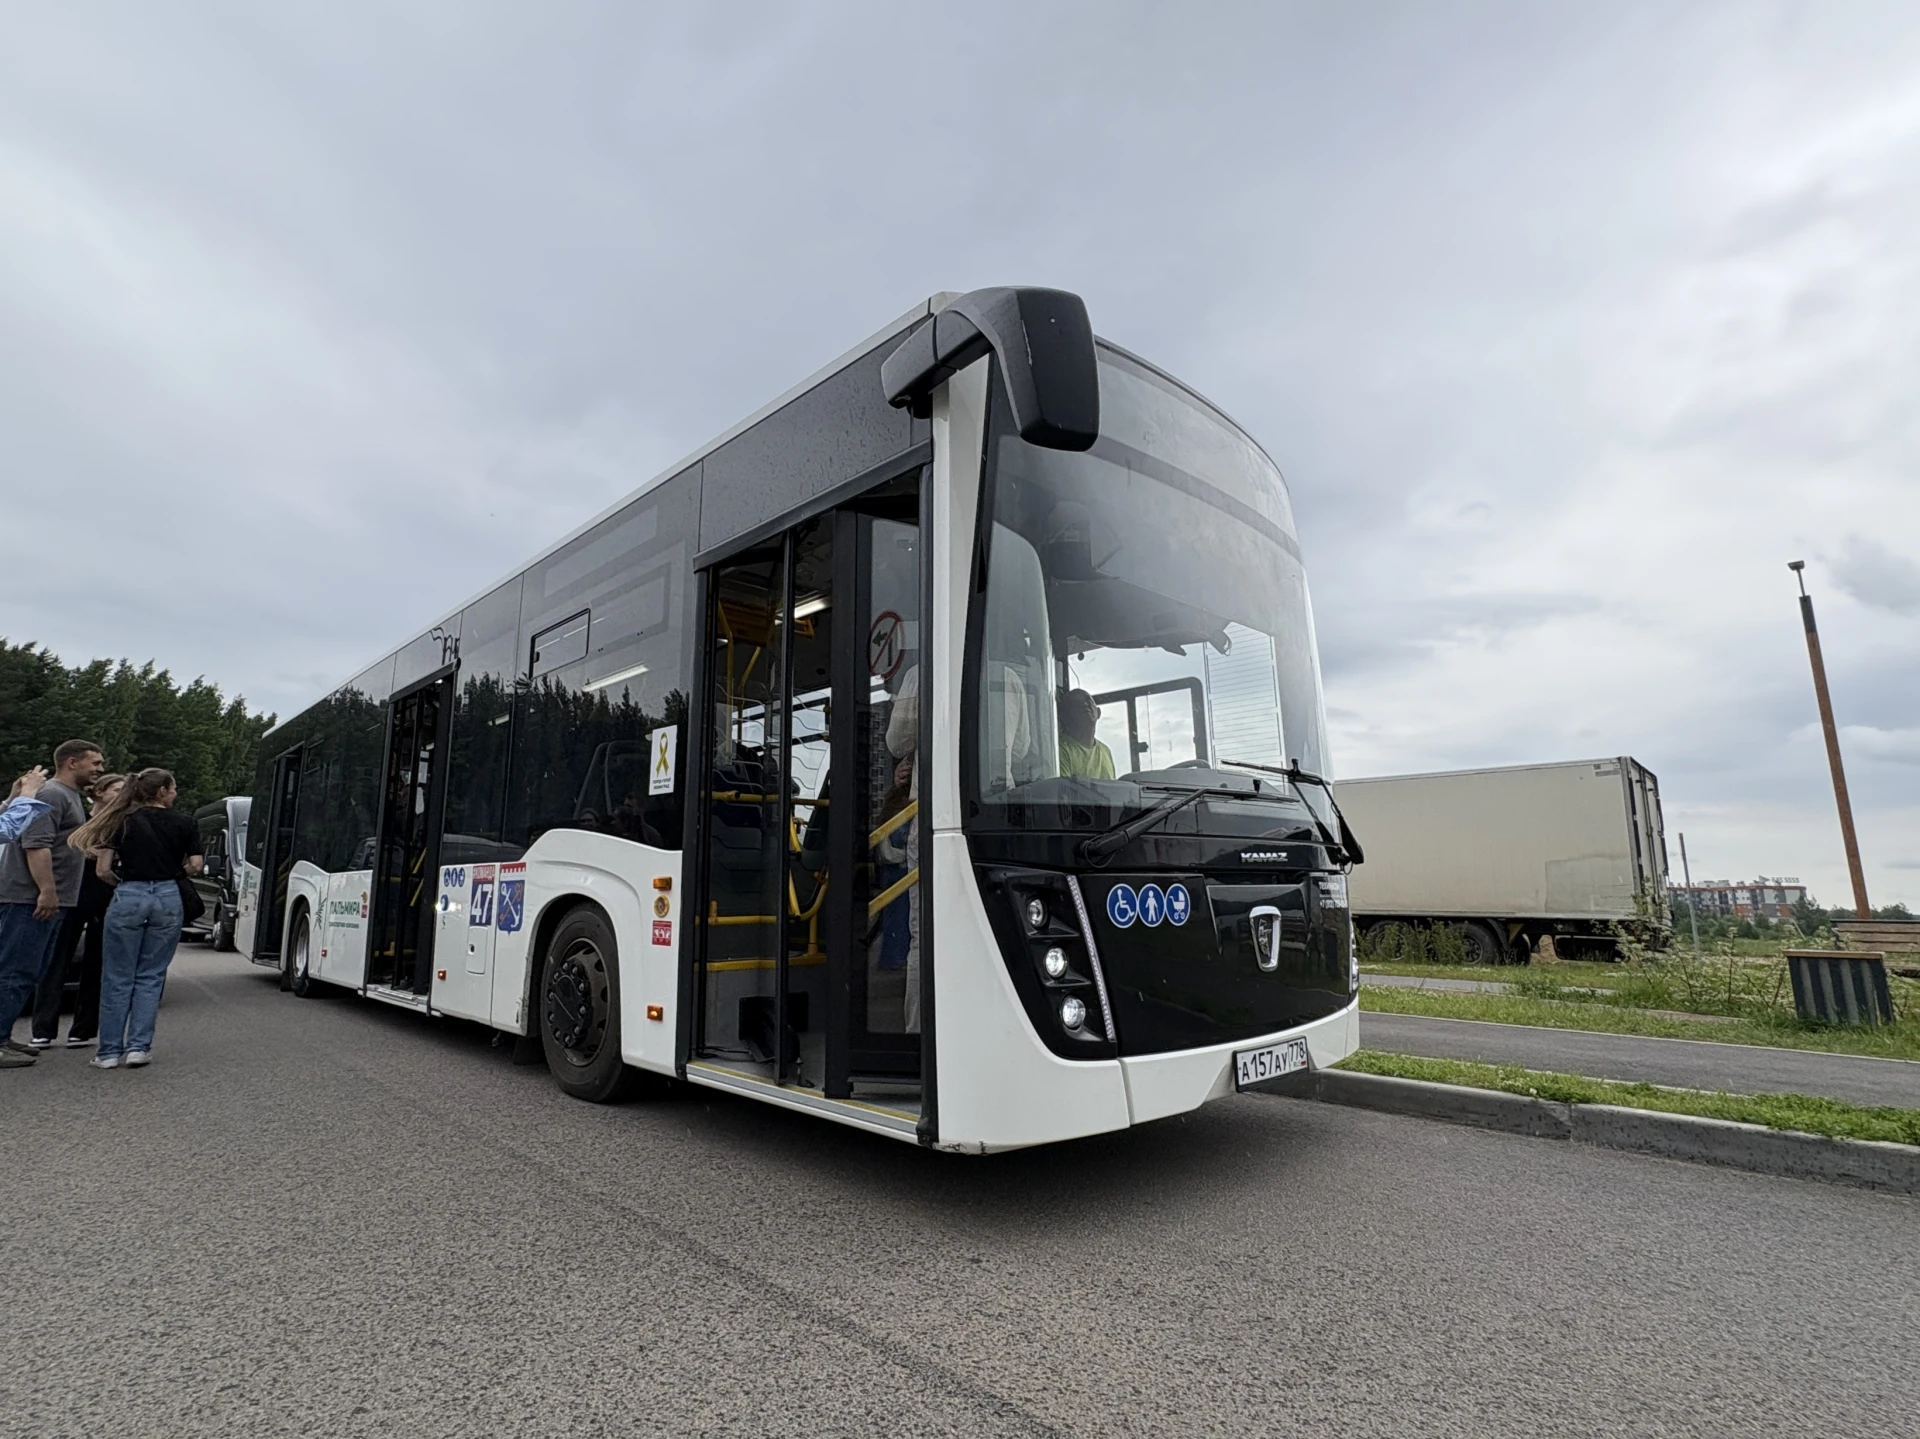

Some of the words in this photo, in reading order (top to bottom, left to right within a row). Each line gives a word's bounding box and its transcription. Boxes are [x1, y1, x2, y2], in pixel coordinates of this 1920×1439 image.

[1240, 852, 1288, 863] KAMAZ
[330, 901, 360, 916] ПАЛЬМИРА
[472, 884, 493, 923] 47
